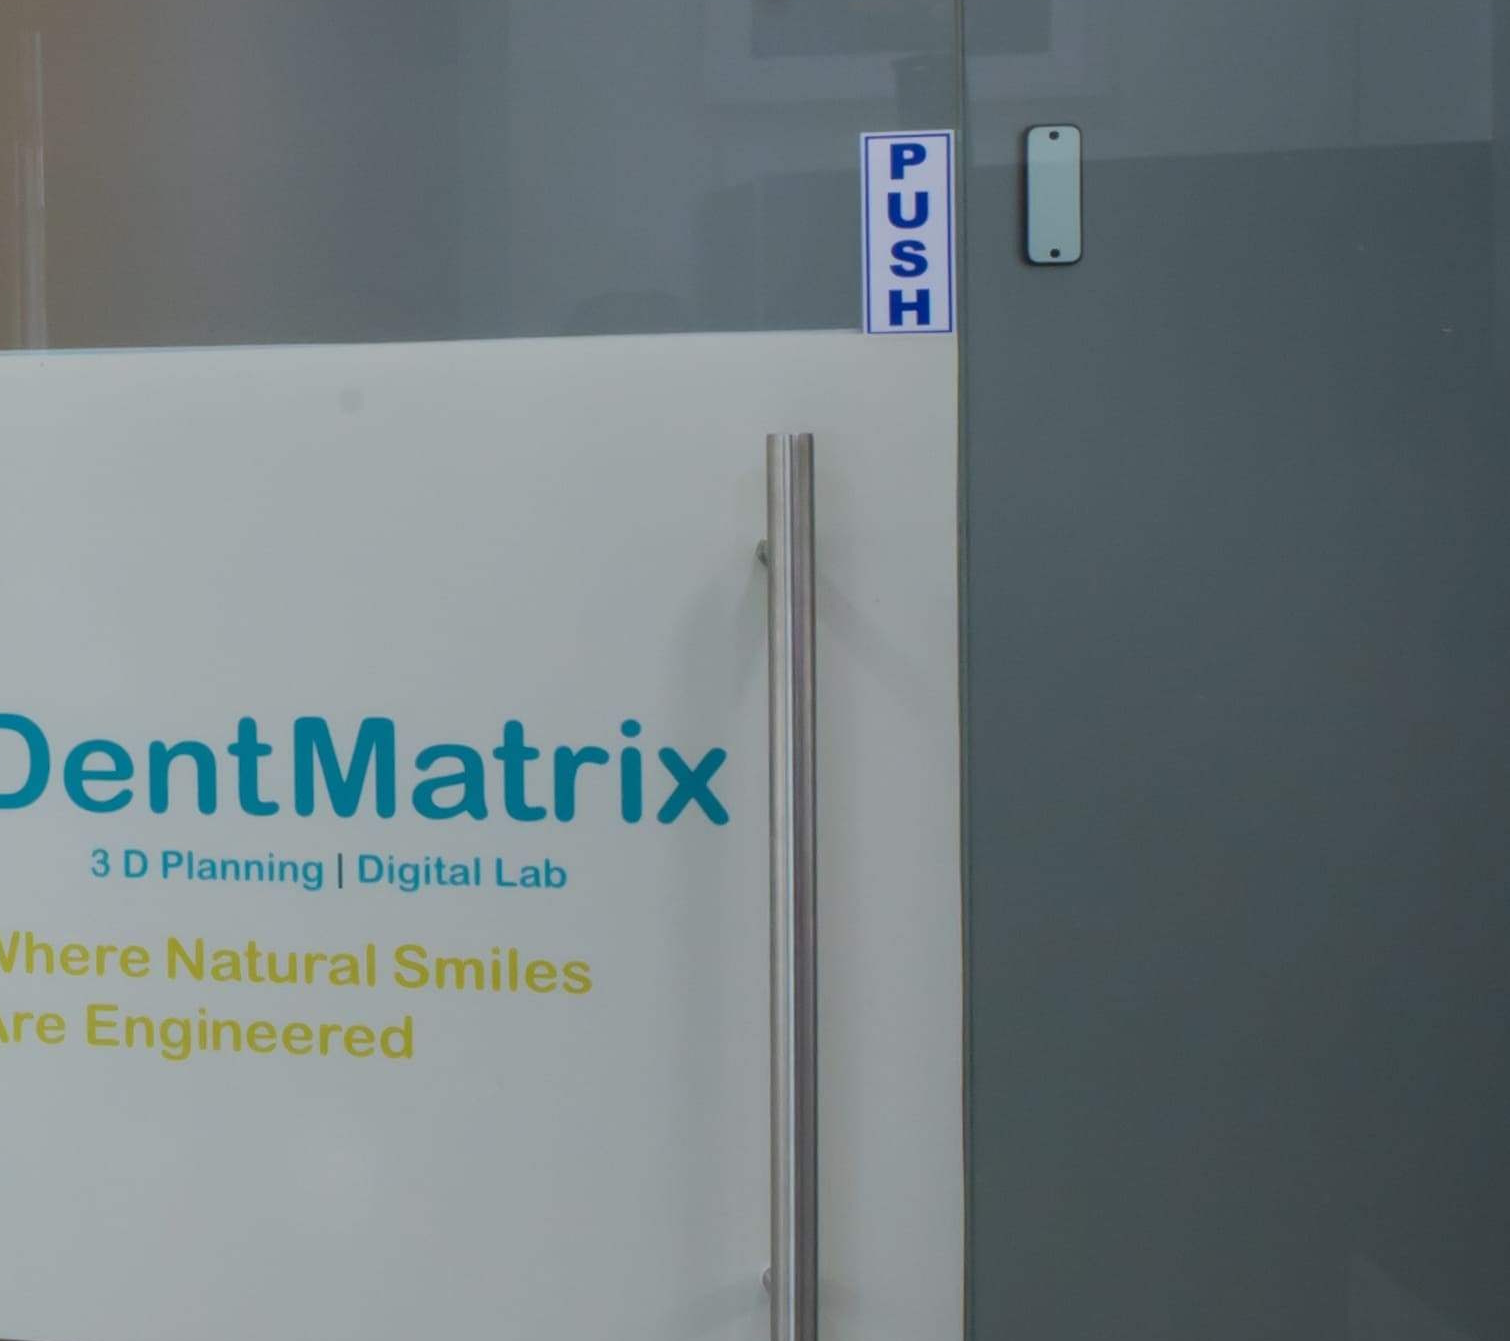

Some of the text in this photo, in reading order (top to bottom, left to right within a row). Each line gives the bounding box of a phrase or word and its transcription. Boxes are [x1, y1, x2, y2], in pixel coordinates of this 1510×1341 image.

[887, 142, 930, 327] PUSH
[90, 848, 111, 878] 3
[123, 849, 149, 879] D
[161, 850, 324, 892] Planning
[358, 853, 481, 893] Digital
[495, 857, 568, 889] Lab
[167, 936, 377, 987] Natural
[393, 943, 593, 995] Smiles
[86, 1003, 414, 1062] Engineered
